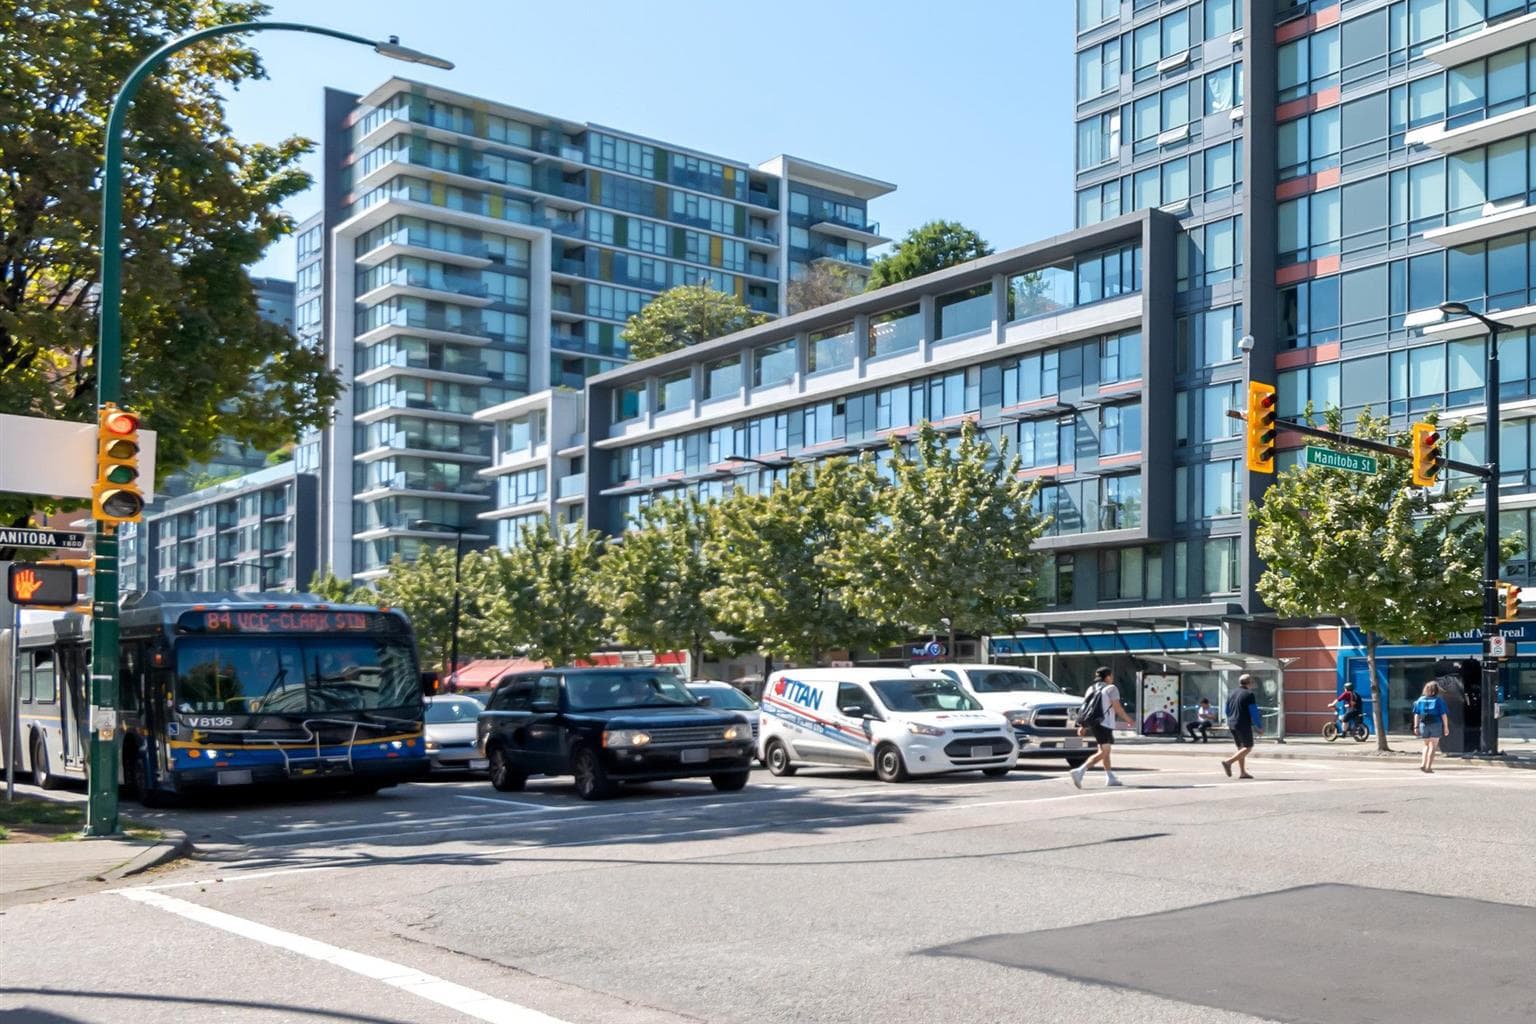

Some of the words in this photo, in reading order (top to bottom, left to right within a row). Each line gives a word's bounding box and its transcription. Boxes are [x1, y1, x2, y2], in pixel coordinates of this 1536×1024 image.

[1314, 451, 1358, 469] Manitoba
[1361, 459, 1371, 471] St
[0, 530, 56, 545] ANITOBA
[207, 612, 232, 629] 84
[236, 612, 329, 630] VCC-CLARK
[1463, 629, 1474, 638] of
[1476, 627, 1525, 638] Mtreal
[782, 678, 823, 710] TITAN
